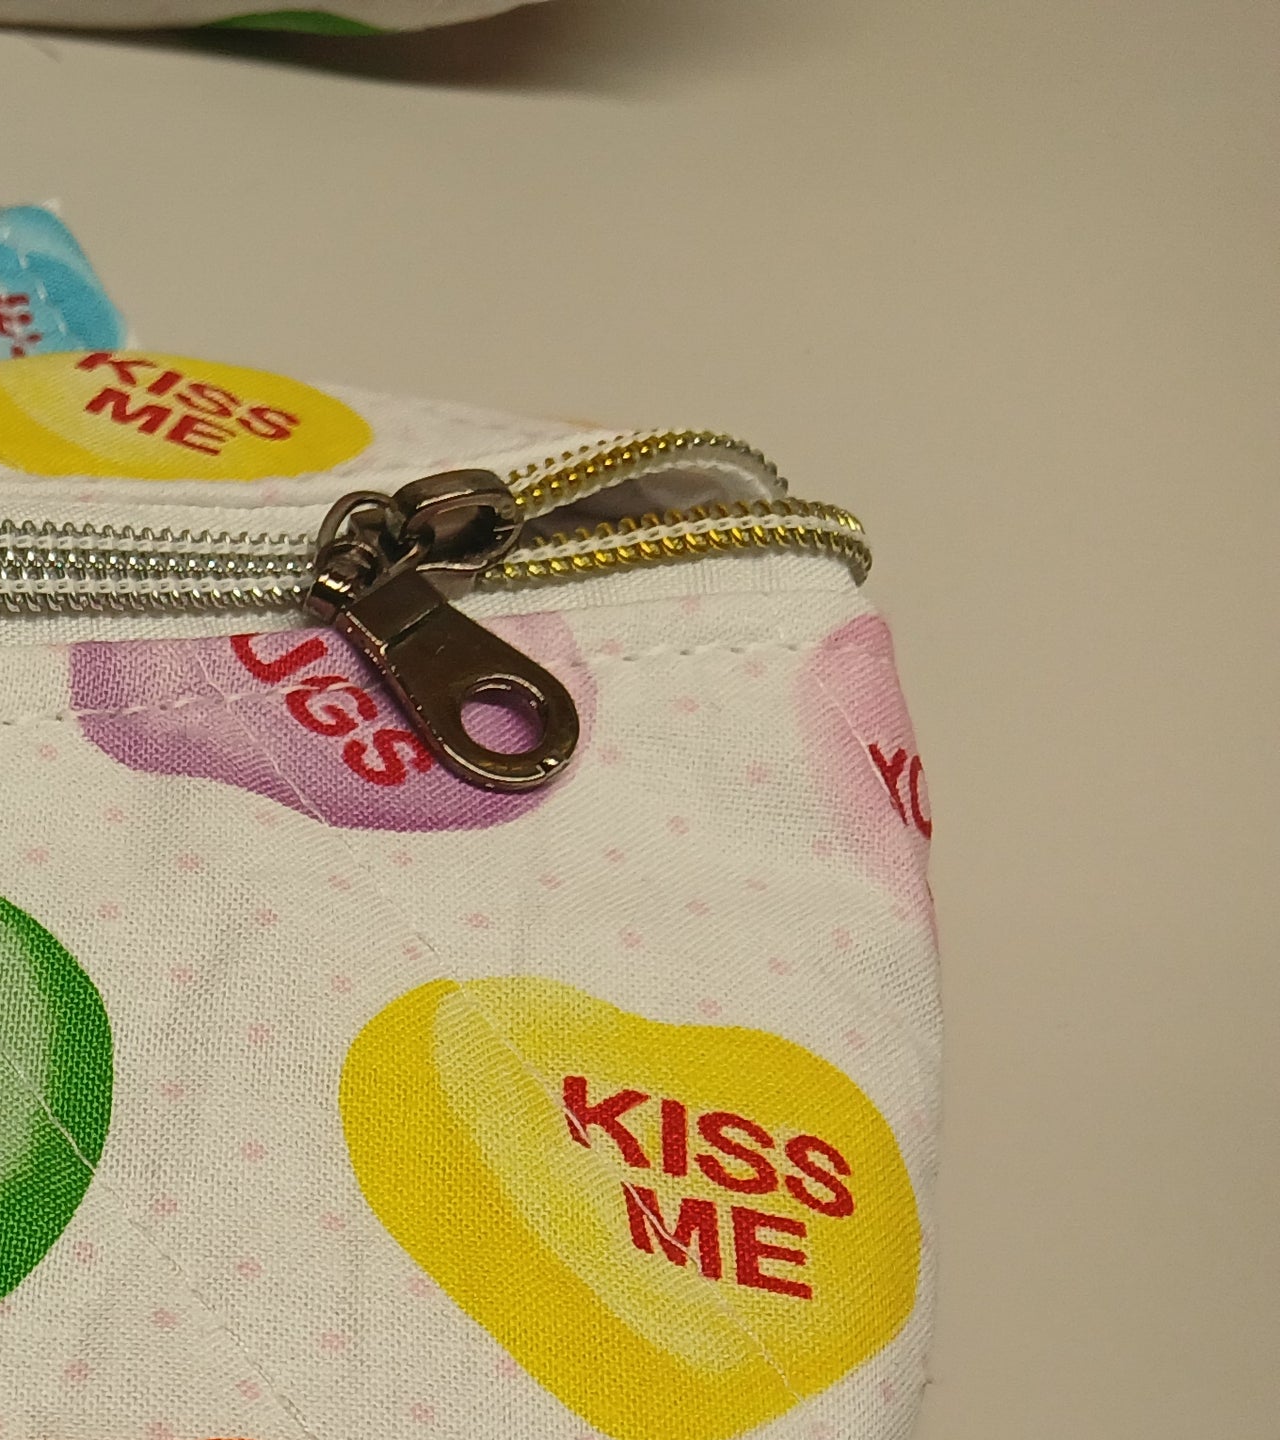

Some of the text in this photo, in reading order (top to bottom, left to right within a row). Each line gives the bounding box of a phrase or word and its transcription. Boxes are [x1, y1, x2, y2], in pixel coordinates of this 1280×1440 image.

[75, 352, 301, 441] KISS
[84, 387, 237, 457] ME
[561, 1074, 855, 1219] KISS
[622, 1184, 813, 1301] ME
